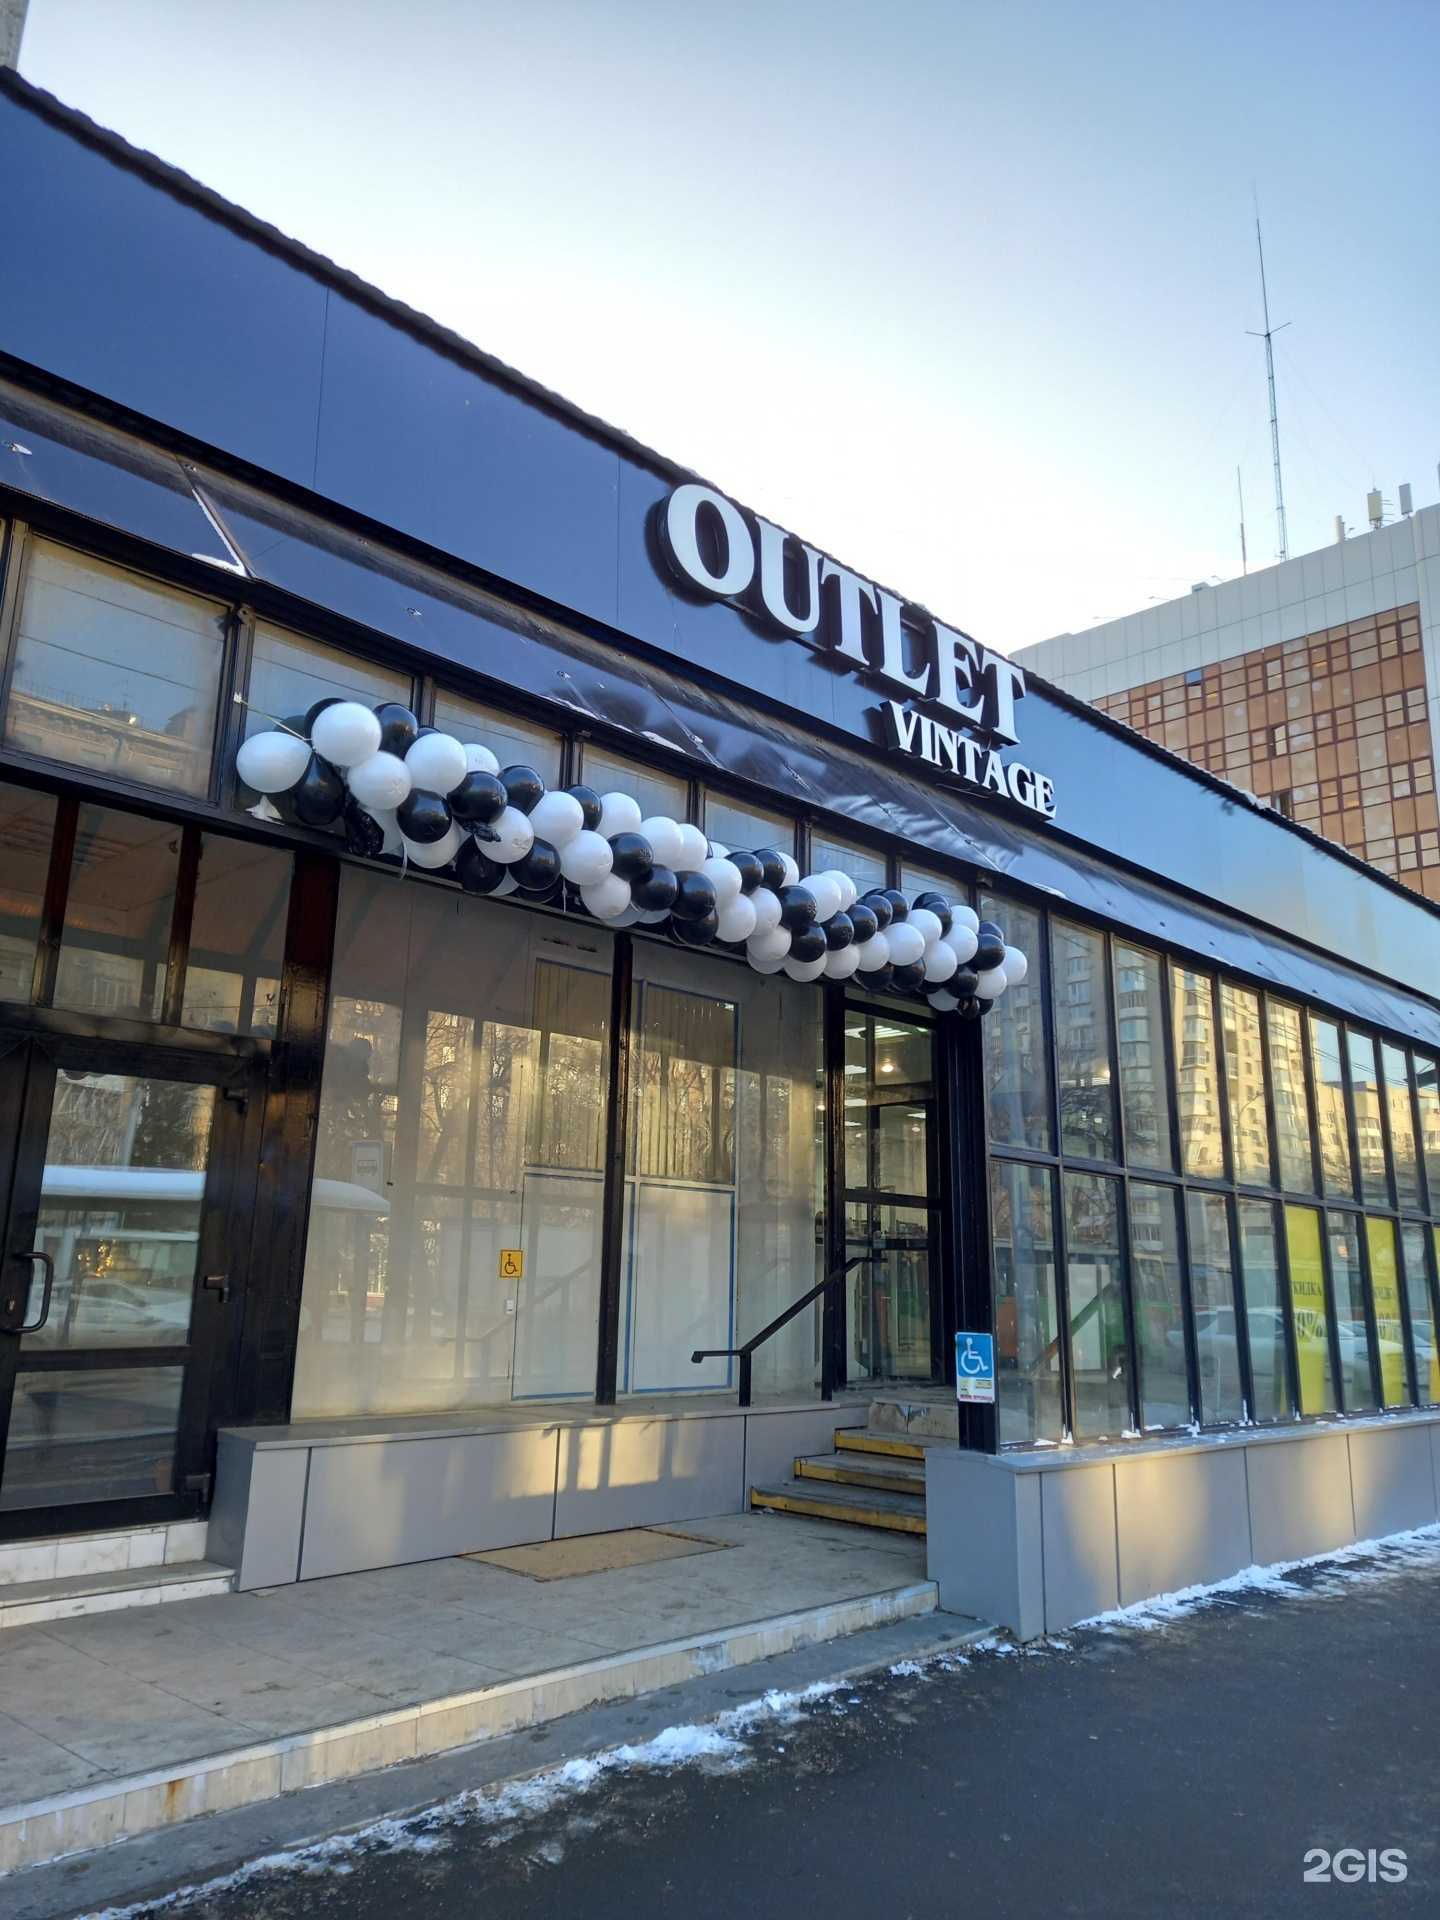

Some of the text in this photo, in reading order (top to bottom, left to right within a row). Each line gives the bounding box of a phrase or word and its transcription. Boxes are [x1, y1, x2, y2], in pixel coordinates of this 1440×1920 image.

[667, 483, 1026, 743] OUTLET
[888, 700, 1057, 819] VINTAGE
[1292, 1280, 1322, 1296] КИДКА
